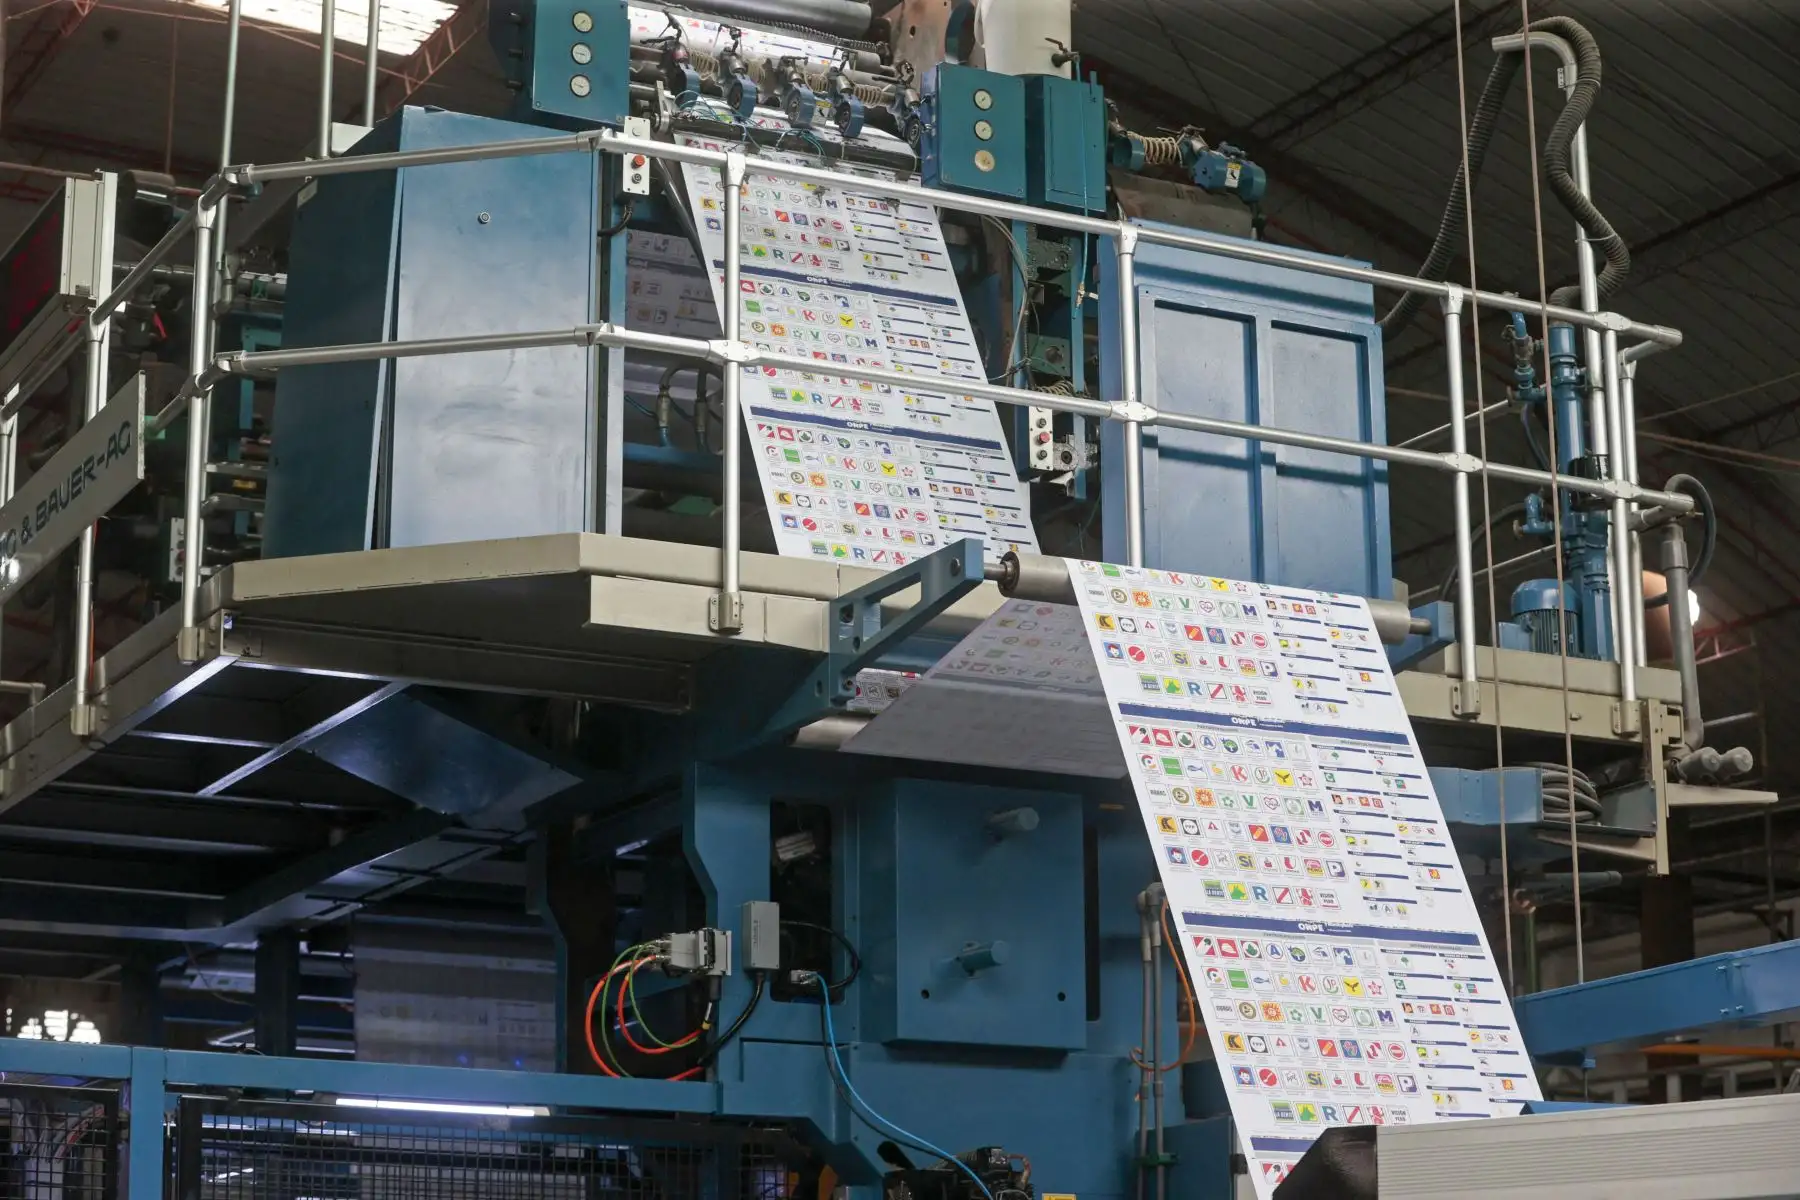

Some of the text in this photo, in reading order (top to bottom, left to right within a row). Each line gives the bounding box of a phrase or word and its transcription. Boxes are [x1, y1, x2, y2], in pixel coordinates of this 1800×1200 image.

[20, 515, 33, 545] &
[36, 421, 131, 529] BAUER-AG
[1242, 605, 1257, 616] M
[1187, 682, 1202, 695] R
[1309, 801, 1323, 812] M
[1252, 886, 1268, 900] R
[1377, 1011, 1393, 1021] M
[1323, 1106, 1339, 1121] R
